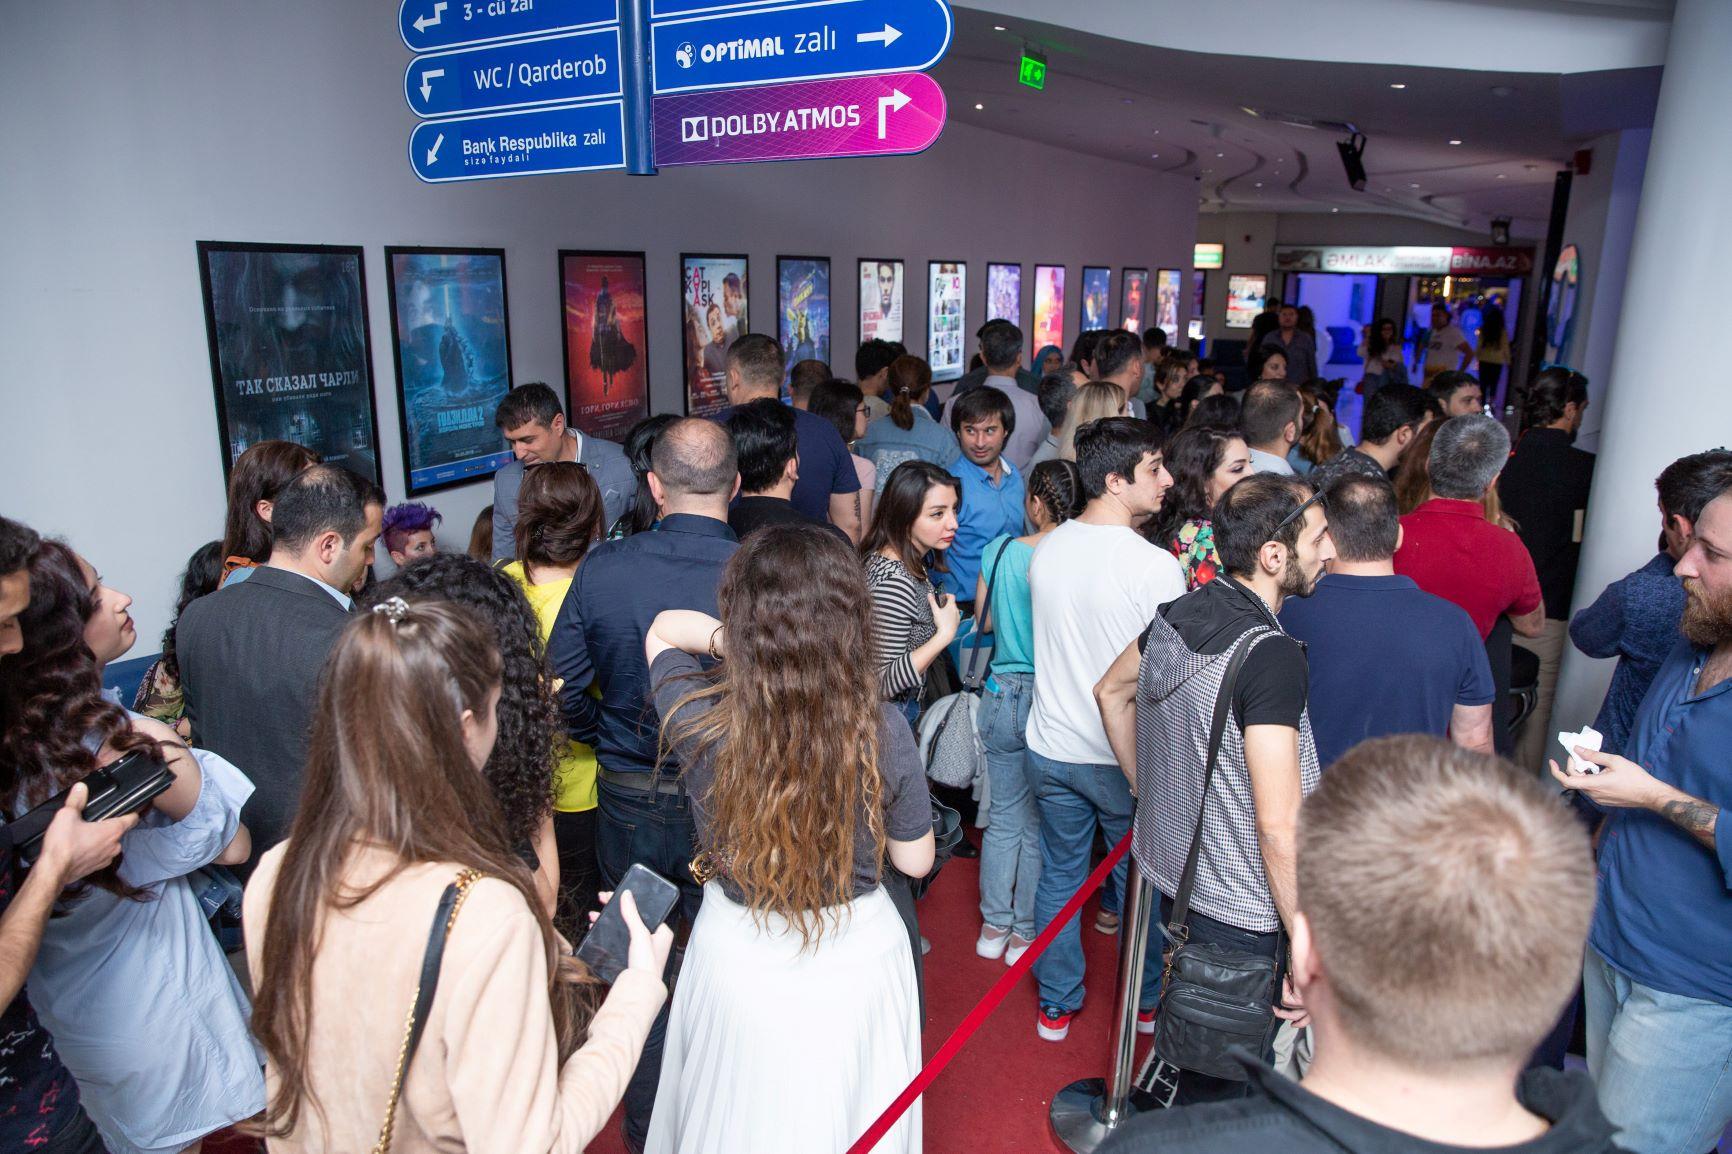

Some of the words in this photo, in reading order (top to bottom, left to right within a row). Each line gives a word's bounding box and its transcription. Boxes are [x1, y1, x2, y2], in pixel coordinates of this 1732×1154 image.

[463, 3, 473, 21] 3
[794, 25, 836, 54] zalı
[474, 66, 503, 90] WC
[506, 63, 514, 89] /
[518, 54, 607, 88] Qarderob
[462, 137, 497, 155] Bank
[499, 131, 577, 154] Respublika
[583, 128, 606, 147] zalı
[235, 378, 264, 396] ТАК
[266, 373, 317, 393] СКАЗАЛ
[319, 370, 359, 388] ЧАРЛИ
[478, 406, 485, 420] 2
